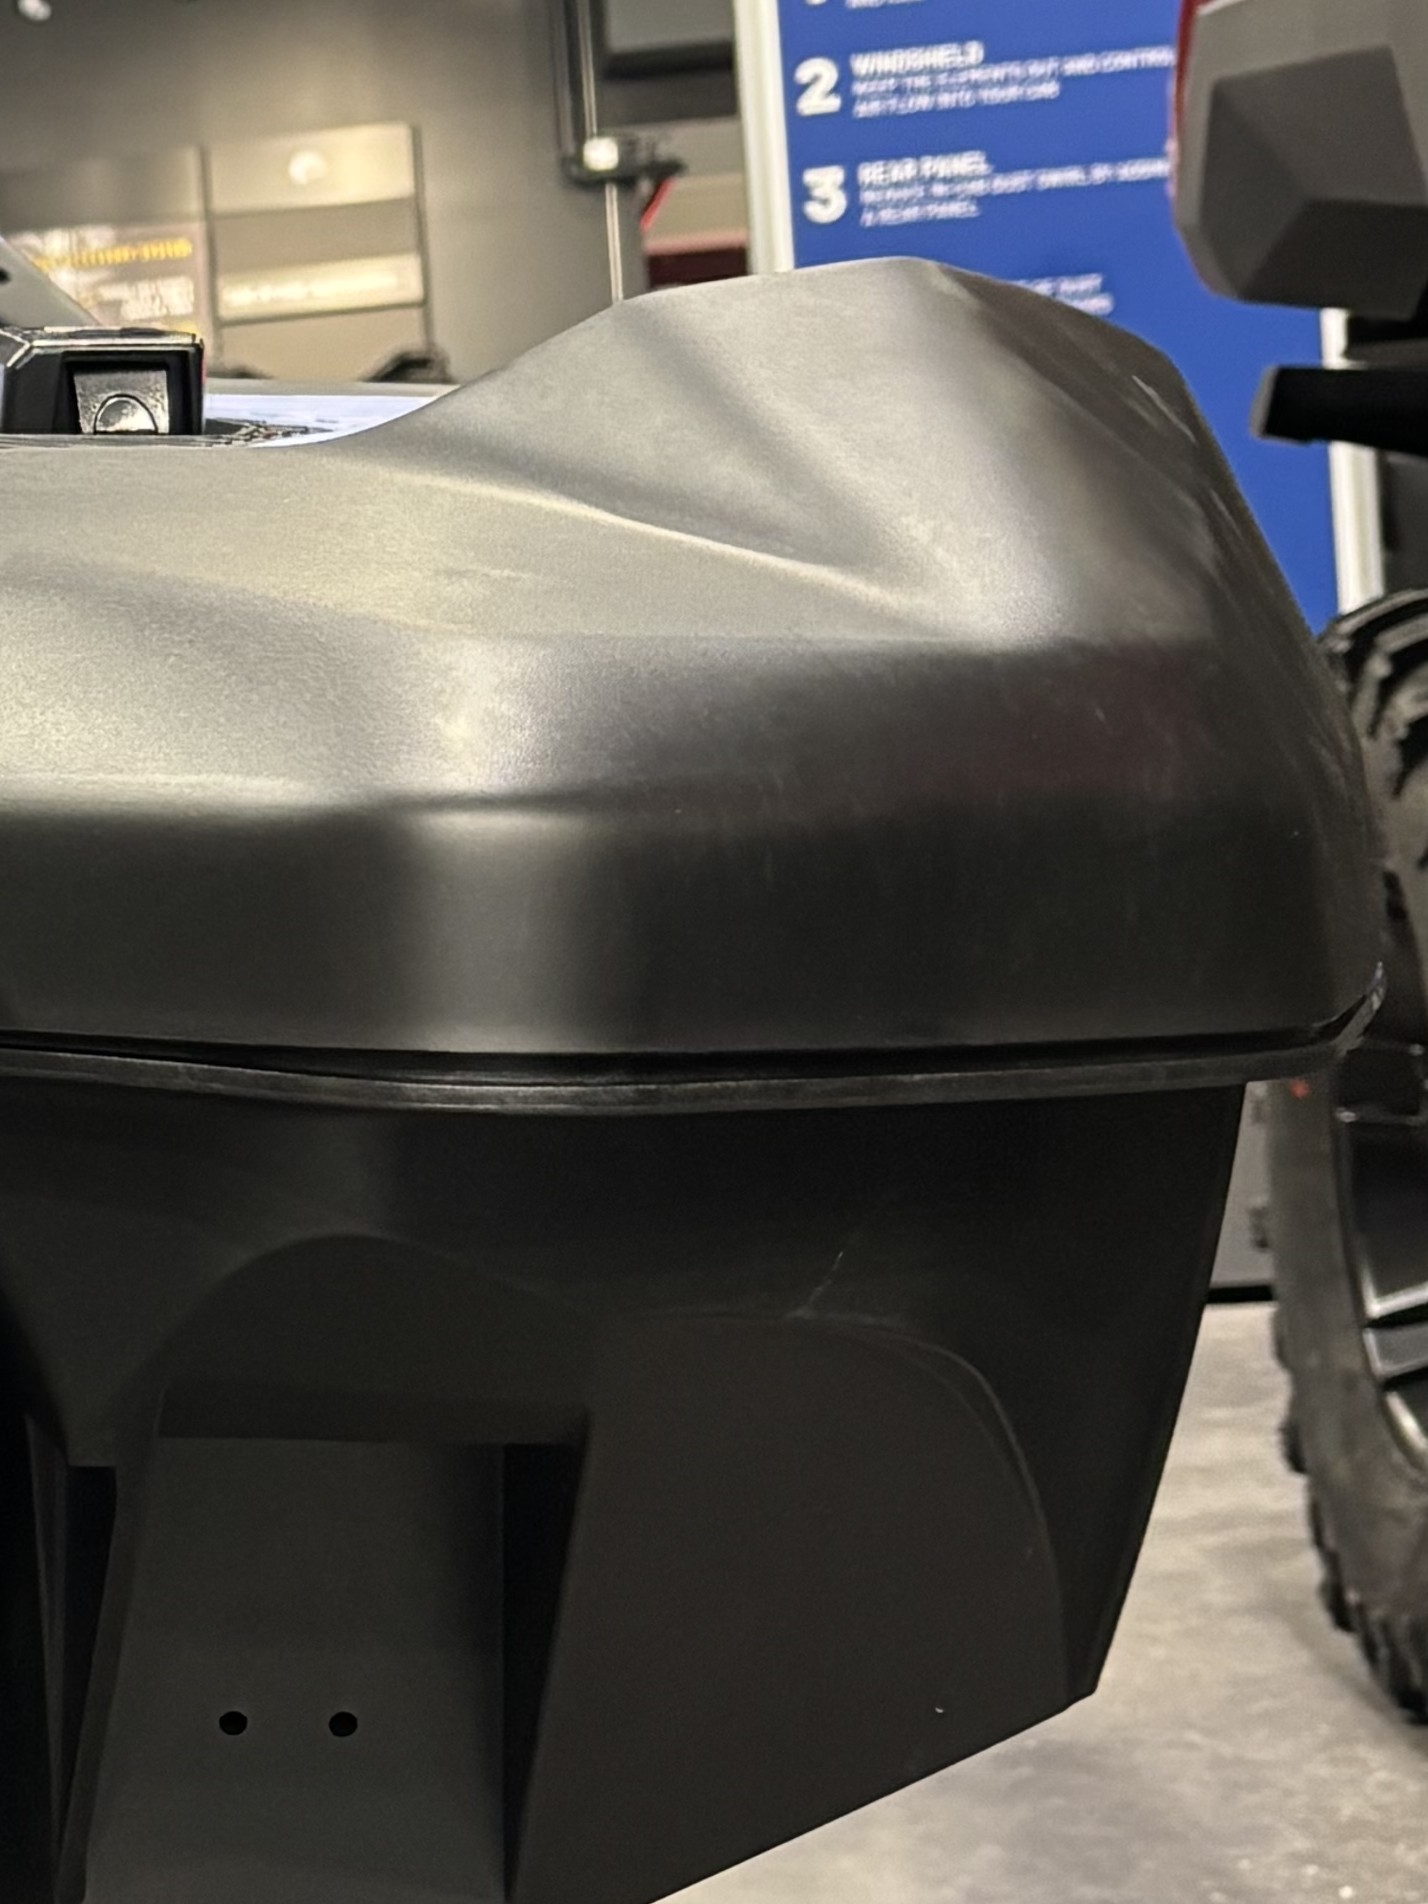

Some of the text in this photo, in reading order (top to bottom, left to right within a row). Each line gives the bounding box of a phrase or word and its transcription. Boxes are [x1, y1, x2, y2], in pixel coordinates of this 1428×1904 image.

[795, 57, 842, 116] 2
[850, 40, 984, 76] WINDSHIELD
[801, 166, 848, 224] 3
